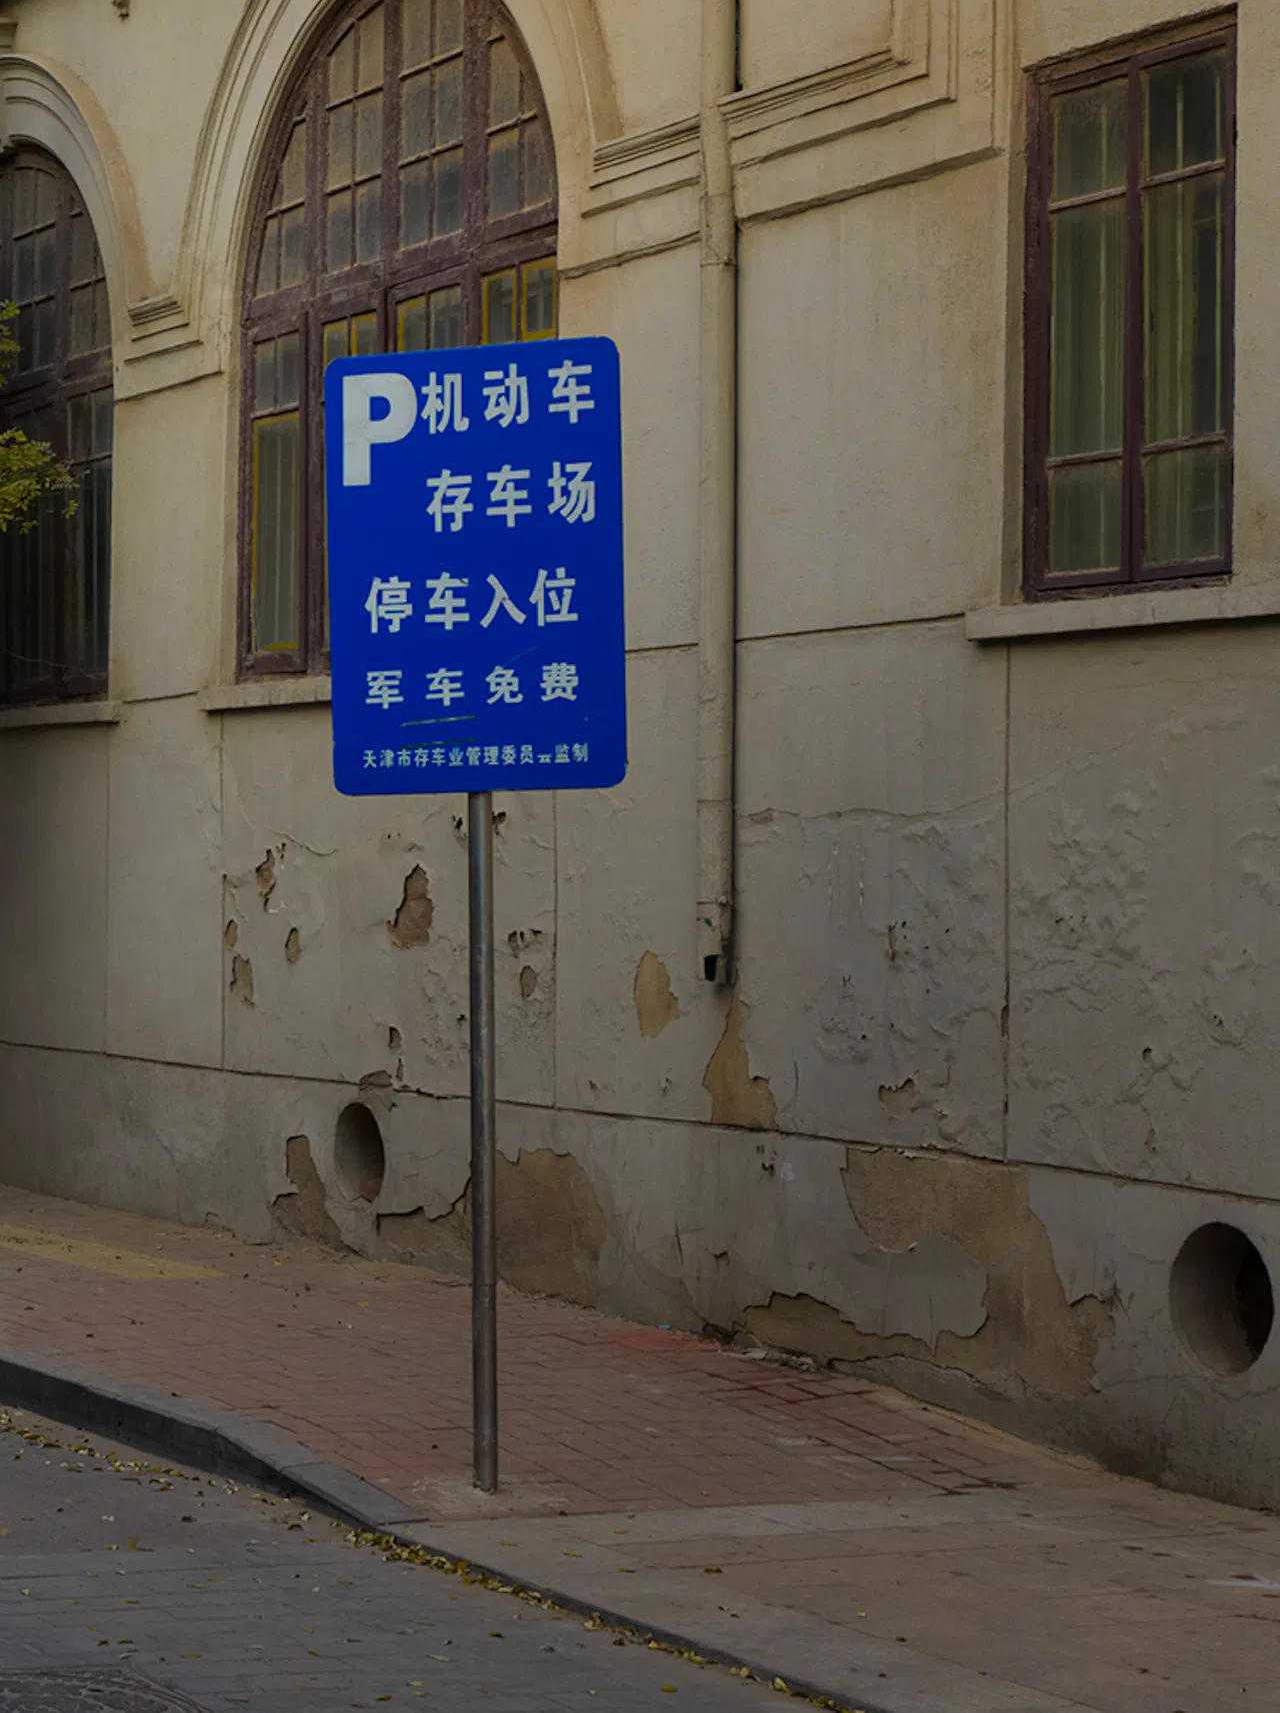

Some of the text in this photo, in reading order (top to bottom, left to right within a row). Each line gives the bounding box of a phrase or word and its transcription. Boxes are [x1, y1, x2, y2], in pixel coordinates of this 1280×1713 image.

[342, 359, 595, 487] P 机动车
[426, 461, 597, 533] 存车场
[364, 567, 579, 634] 停车入位
[365, 662, 580, 709] 军车免费
